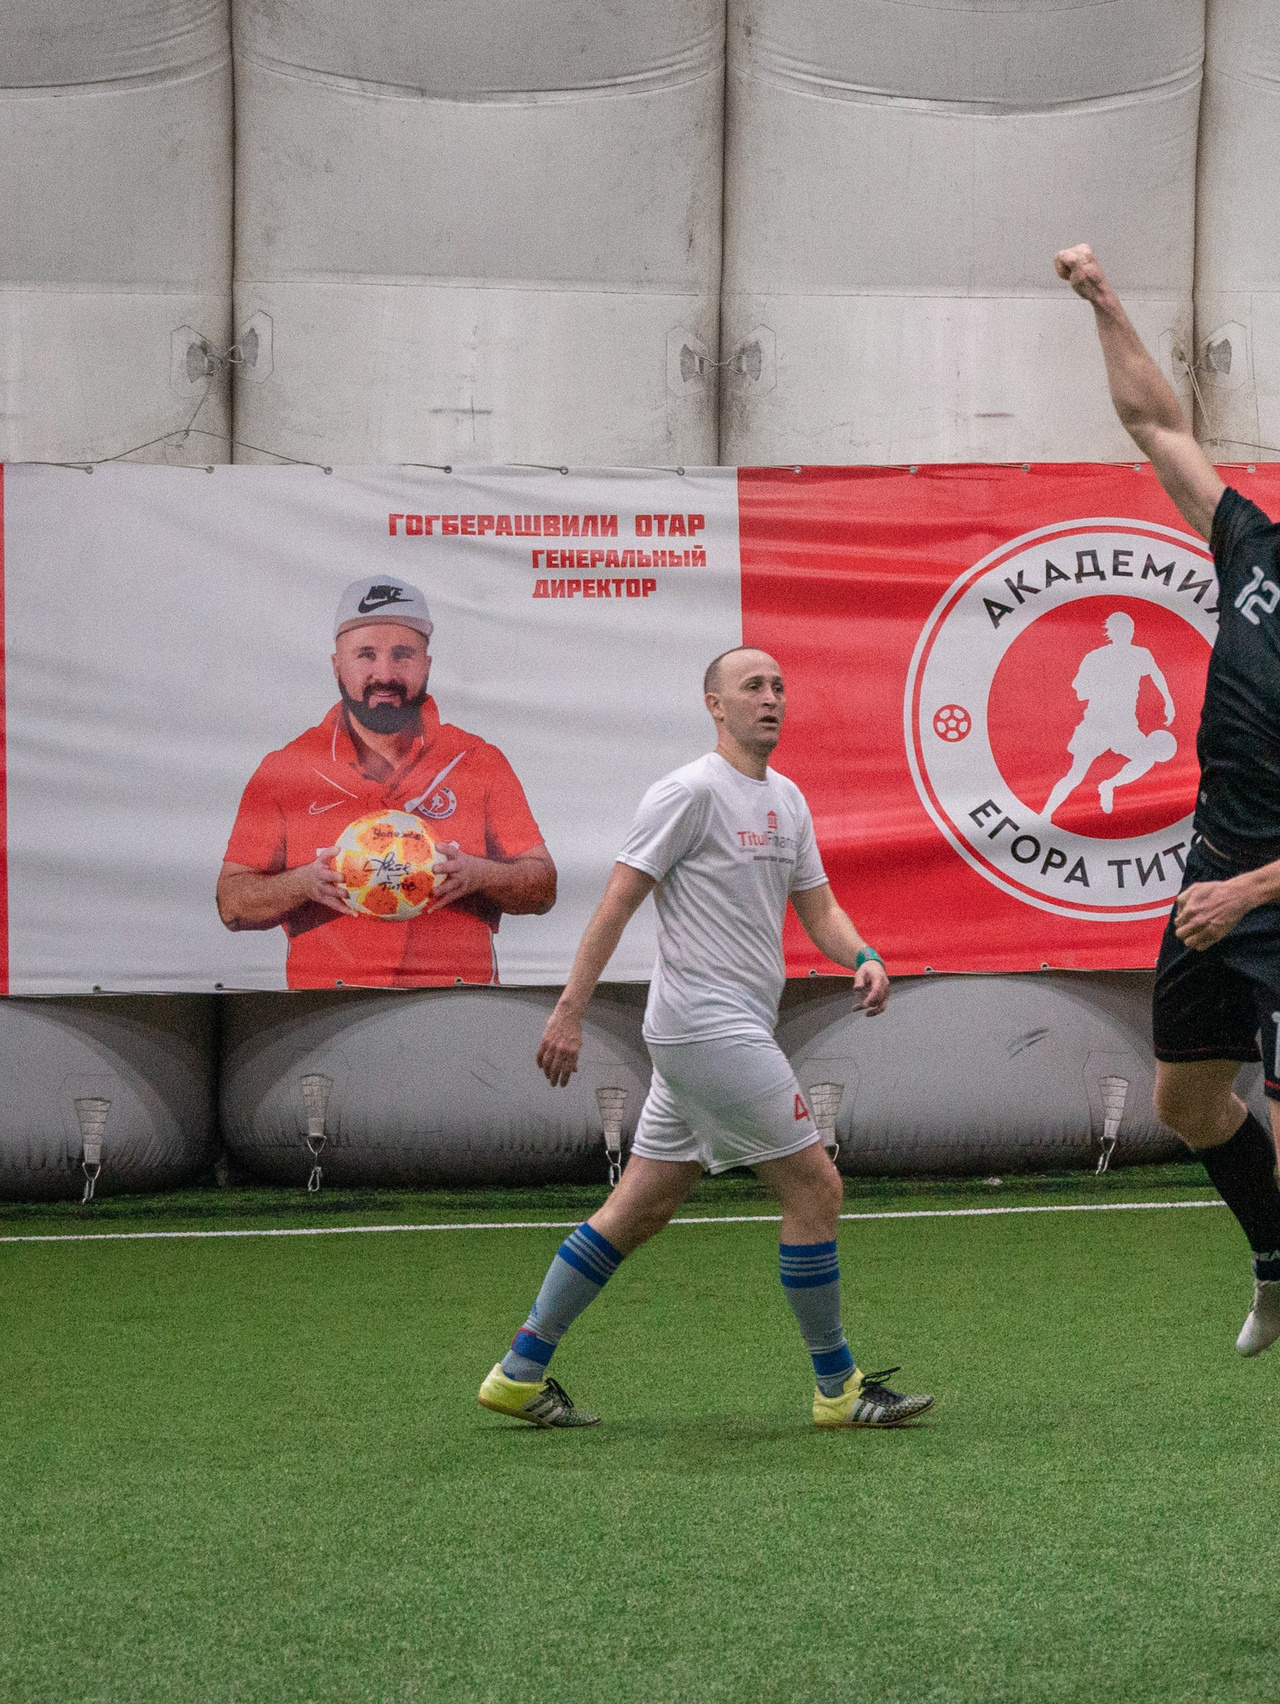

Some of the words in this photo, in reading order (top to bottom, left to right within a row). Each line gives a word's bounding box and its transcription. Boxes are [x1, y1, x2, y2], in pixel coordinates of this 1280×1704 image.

[389, 513, 618, 537] ГОГБЕРАШВИЛИ
[635, 513, 706, 538] ОТАР
[532, 545, 708, 569] ГЕНЕРАЛЬНЫЙ
[532, 578, 657, 599] ДИРЕКТОР
[982, 549, 1220, 629] АКАДЕМИ
[1233, 565, 1280, 626] 12
[968, 799, 1090, 888] ЕГОРА
[1107, 834, 1202, 889] ТИТ
